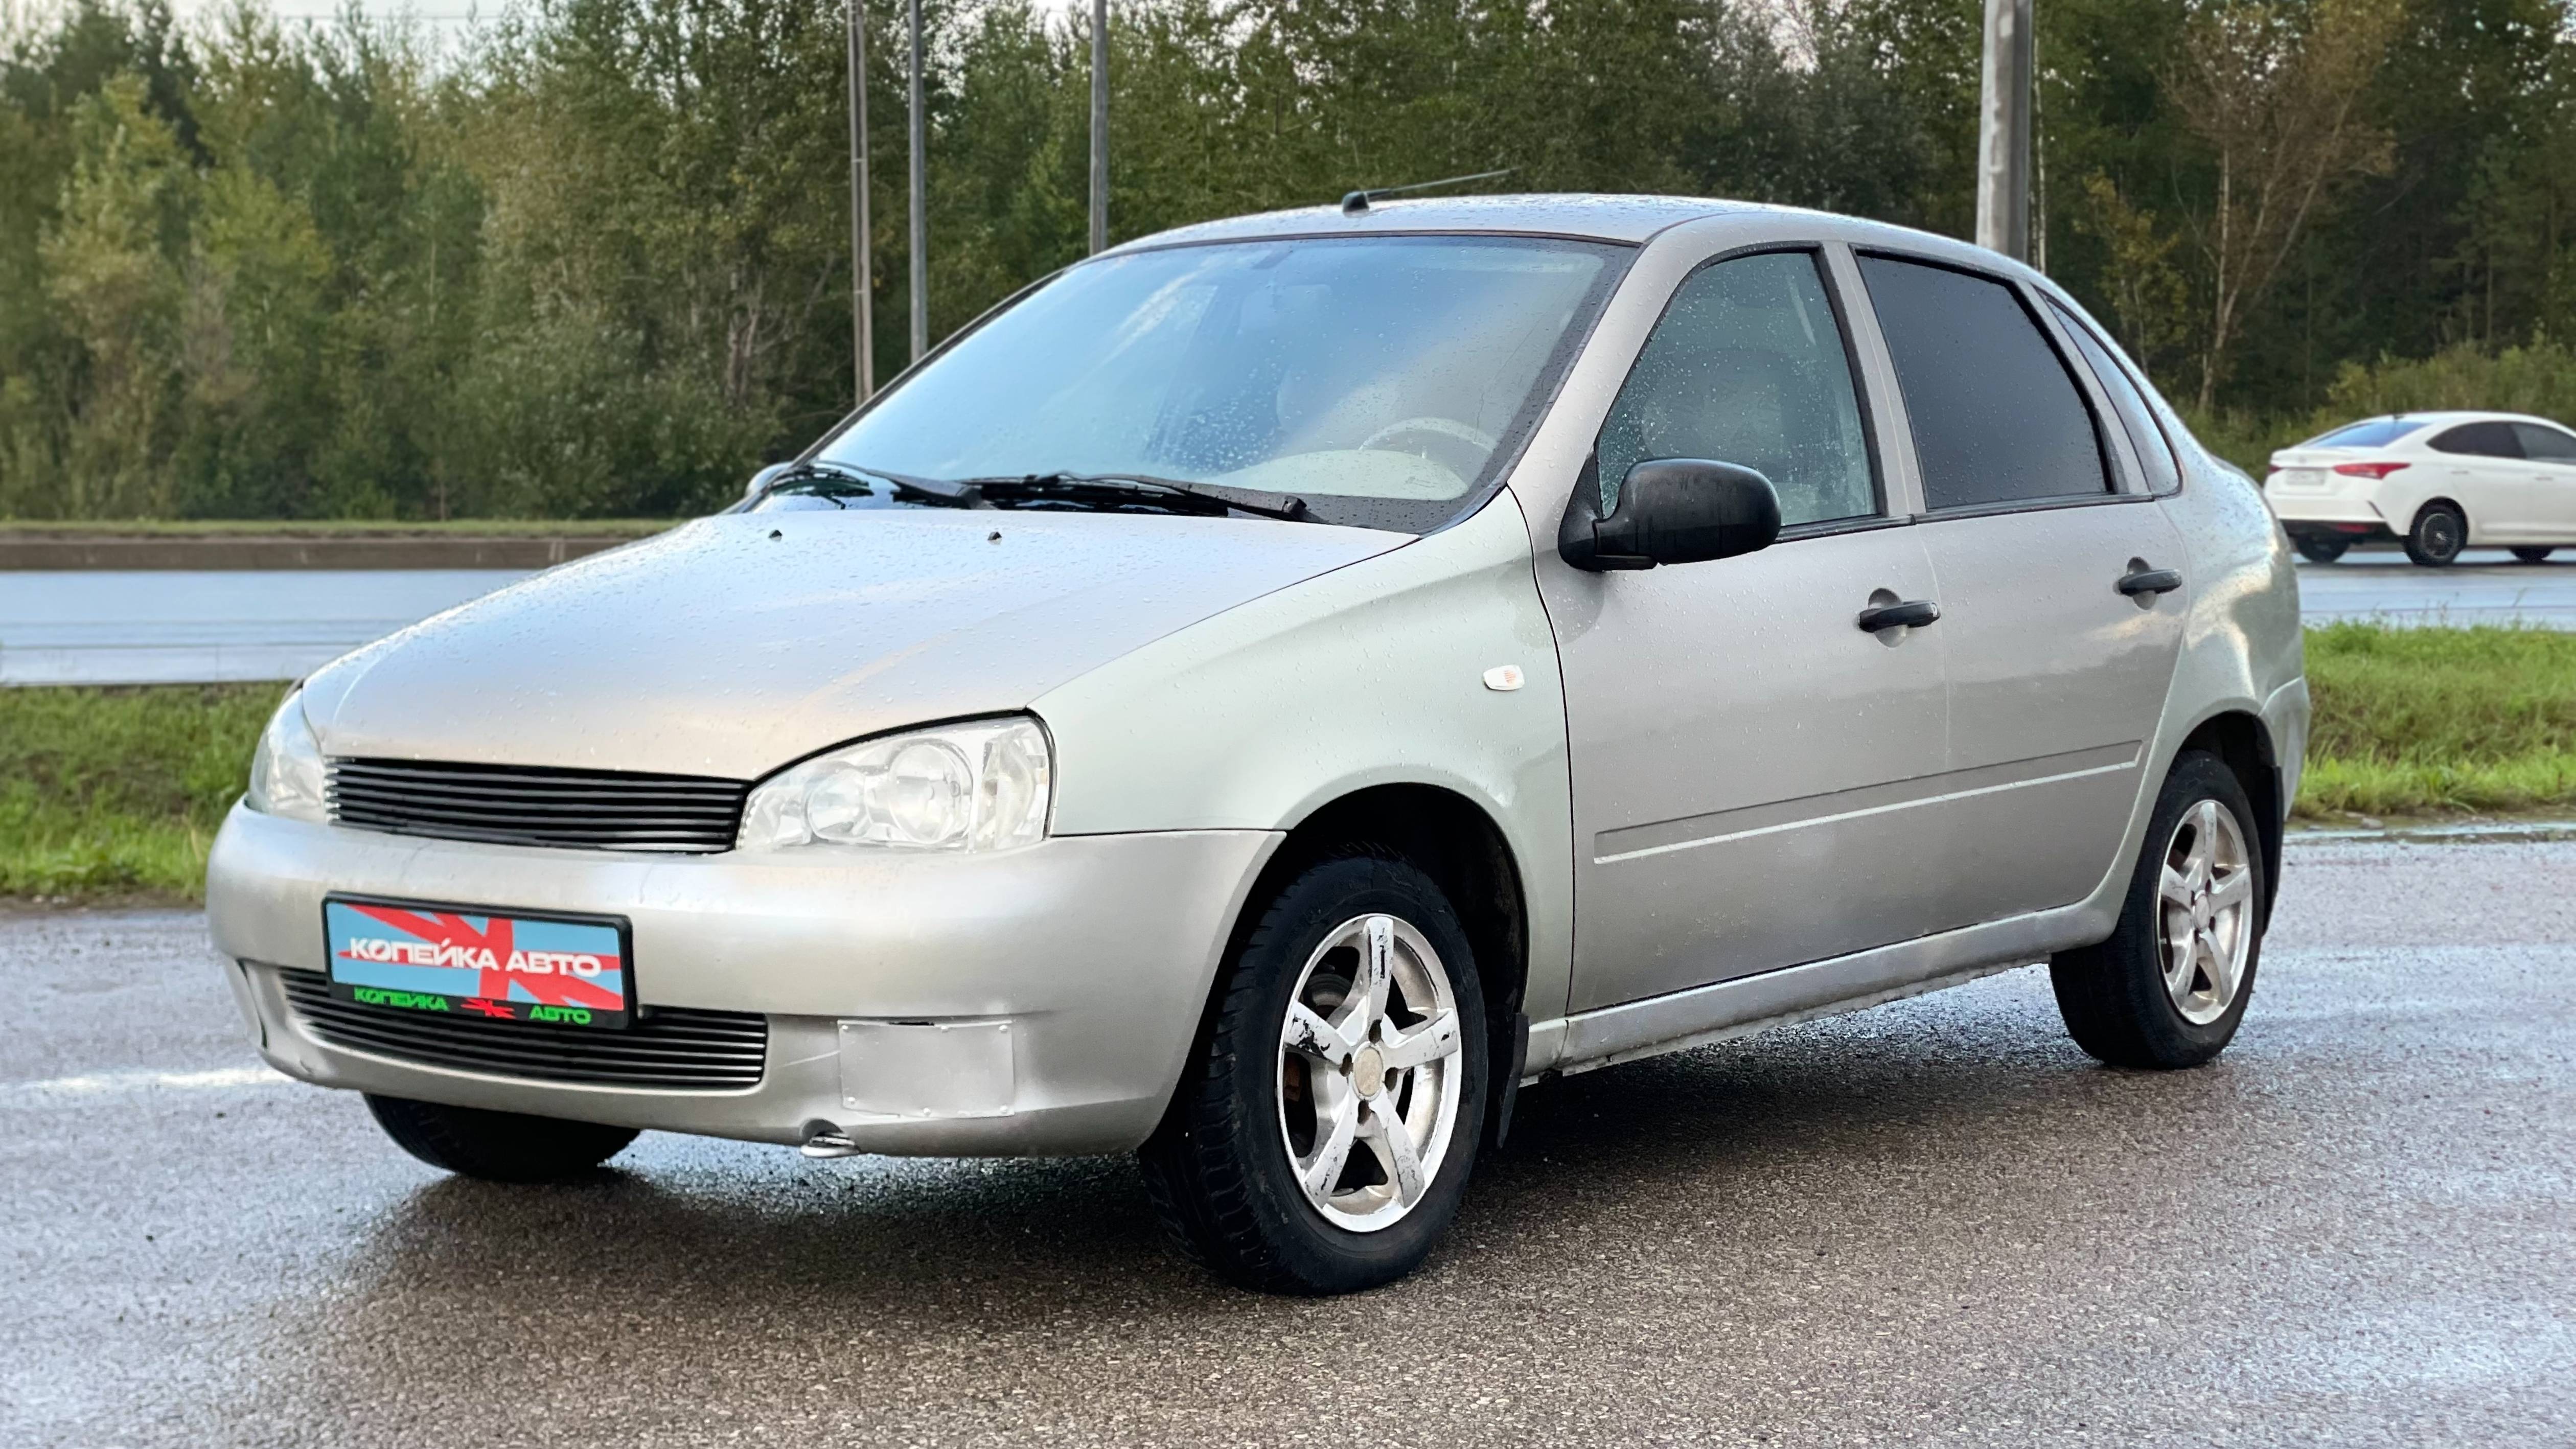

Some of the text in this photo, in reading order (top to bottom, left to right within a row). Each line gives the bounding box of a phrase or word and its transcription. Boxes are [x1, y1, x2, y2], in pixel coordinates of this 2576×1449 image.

[350, 937, 602, 977] КОПЕЙКА АВТО
[529, 1004, 591, 1025] АВТО
